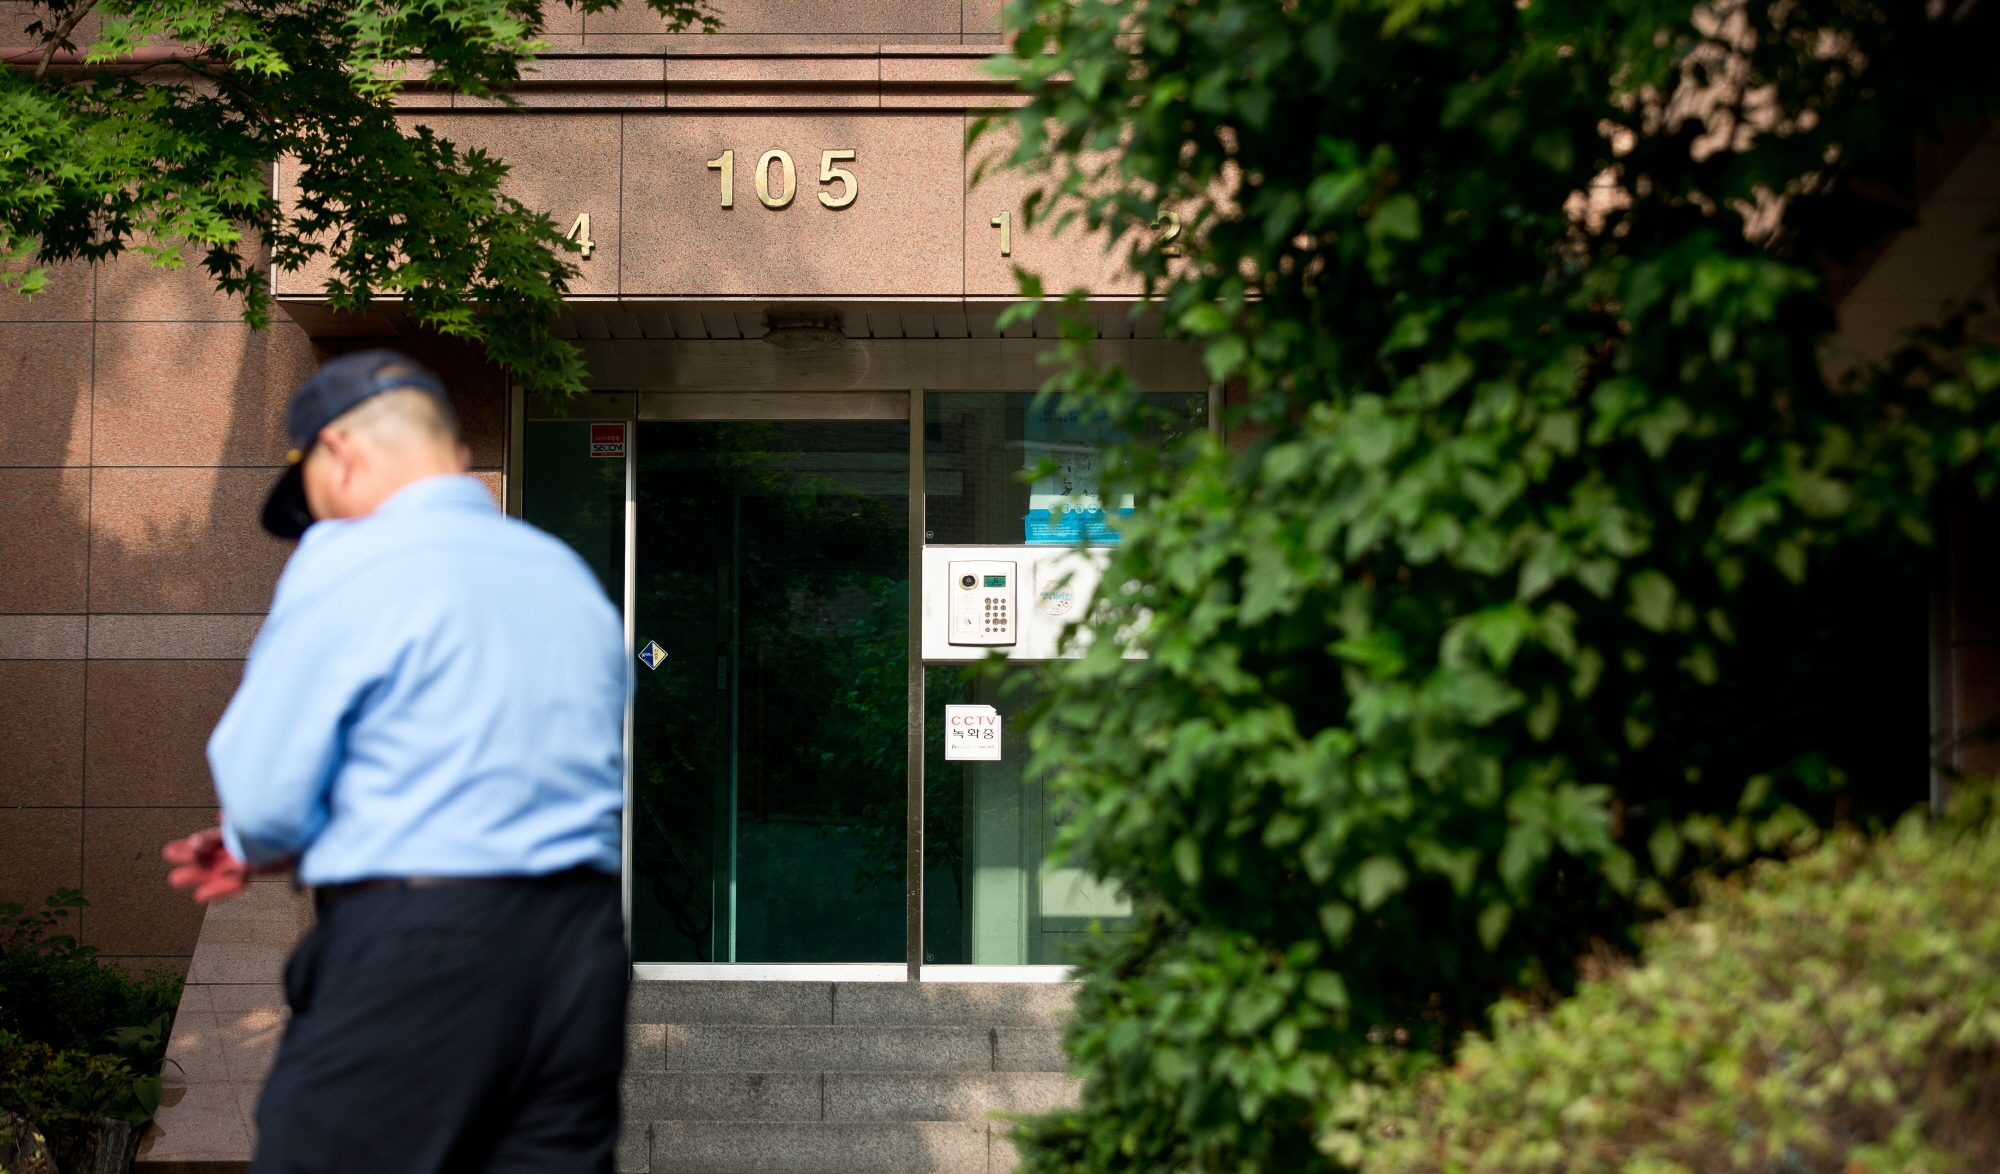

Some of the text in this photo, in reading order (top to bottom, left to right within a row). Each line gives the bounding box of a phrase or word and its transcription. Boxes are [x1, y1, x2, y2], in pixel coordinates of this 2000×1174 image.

[706, 148, 859, 210] 105
[566, 212, 595, 259] 4
[990, 210, 1011, 256] 1
[1151, 210, 1181, 258] 2
[951, 716, 995, 725] CCTV
[953, 729, 994, 739] 녹화중
